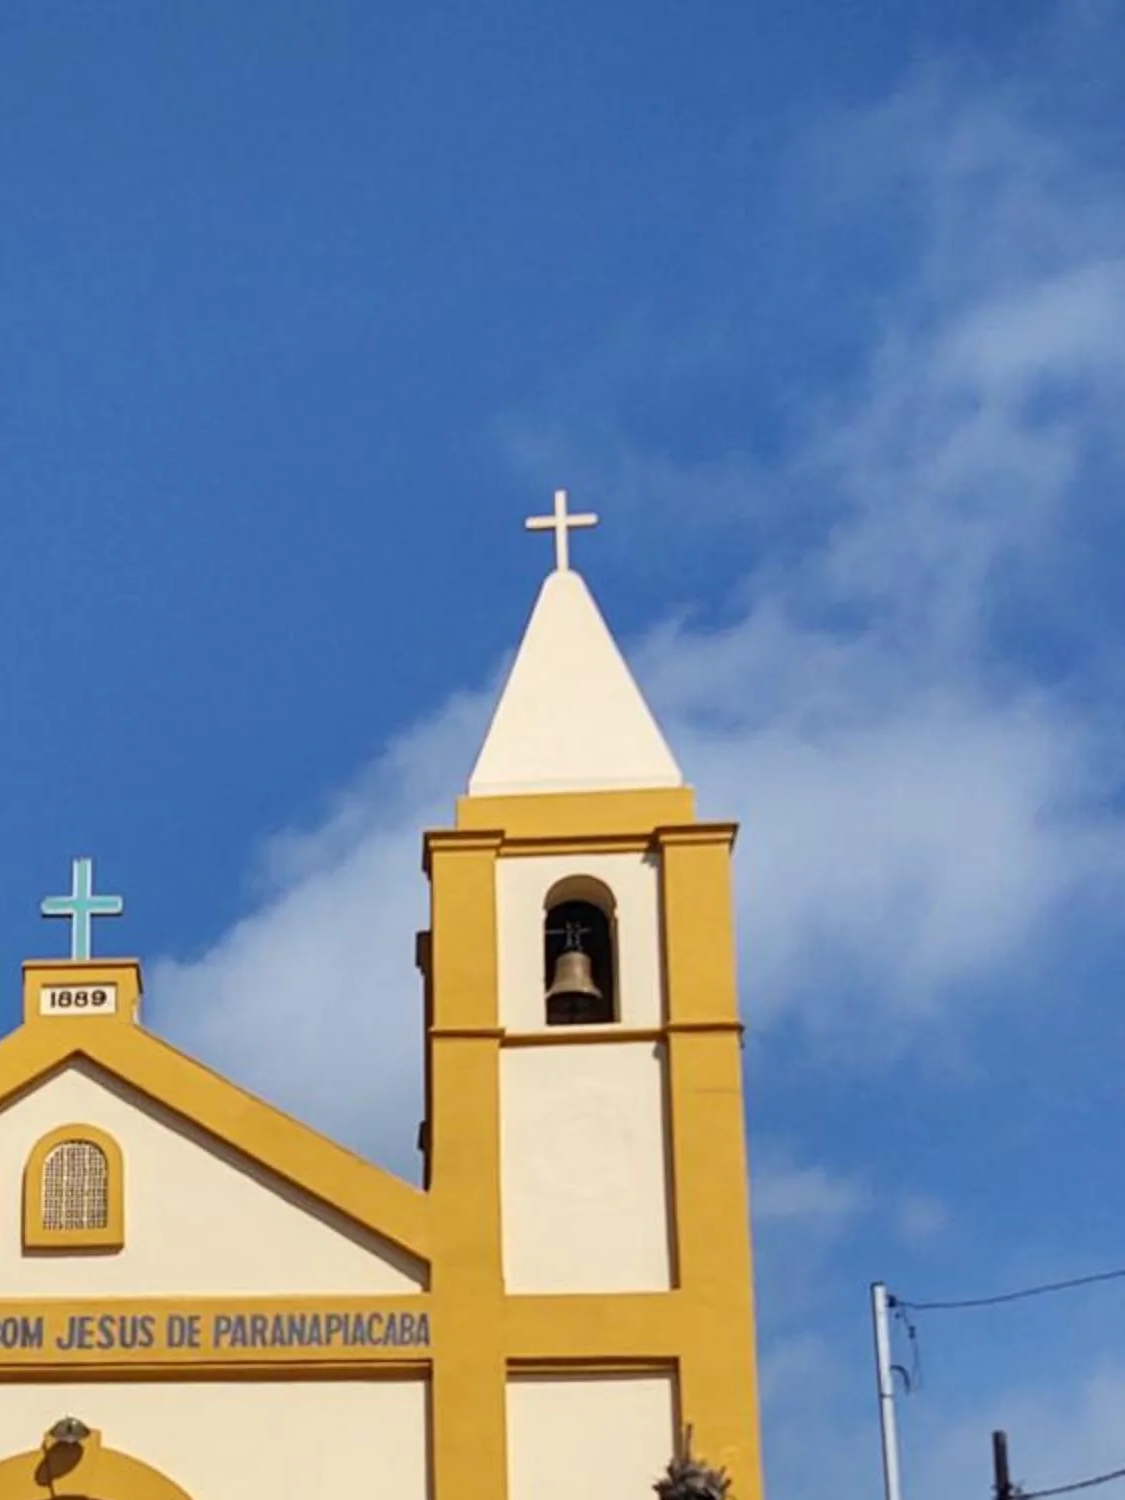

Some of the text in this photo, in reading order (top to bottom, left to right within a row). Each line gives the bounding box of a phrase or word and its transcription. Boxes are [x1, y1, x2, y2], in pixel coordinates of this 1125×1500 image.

[50, 989, 107, 1009] 1889
[56, 1315, 155, 1350] JESUS
[167, 1314, 201, 1348] DE
[213, 1312, 430, 1348] PARANAPIACABA
